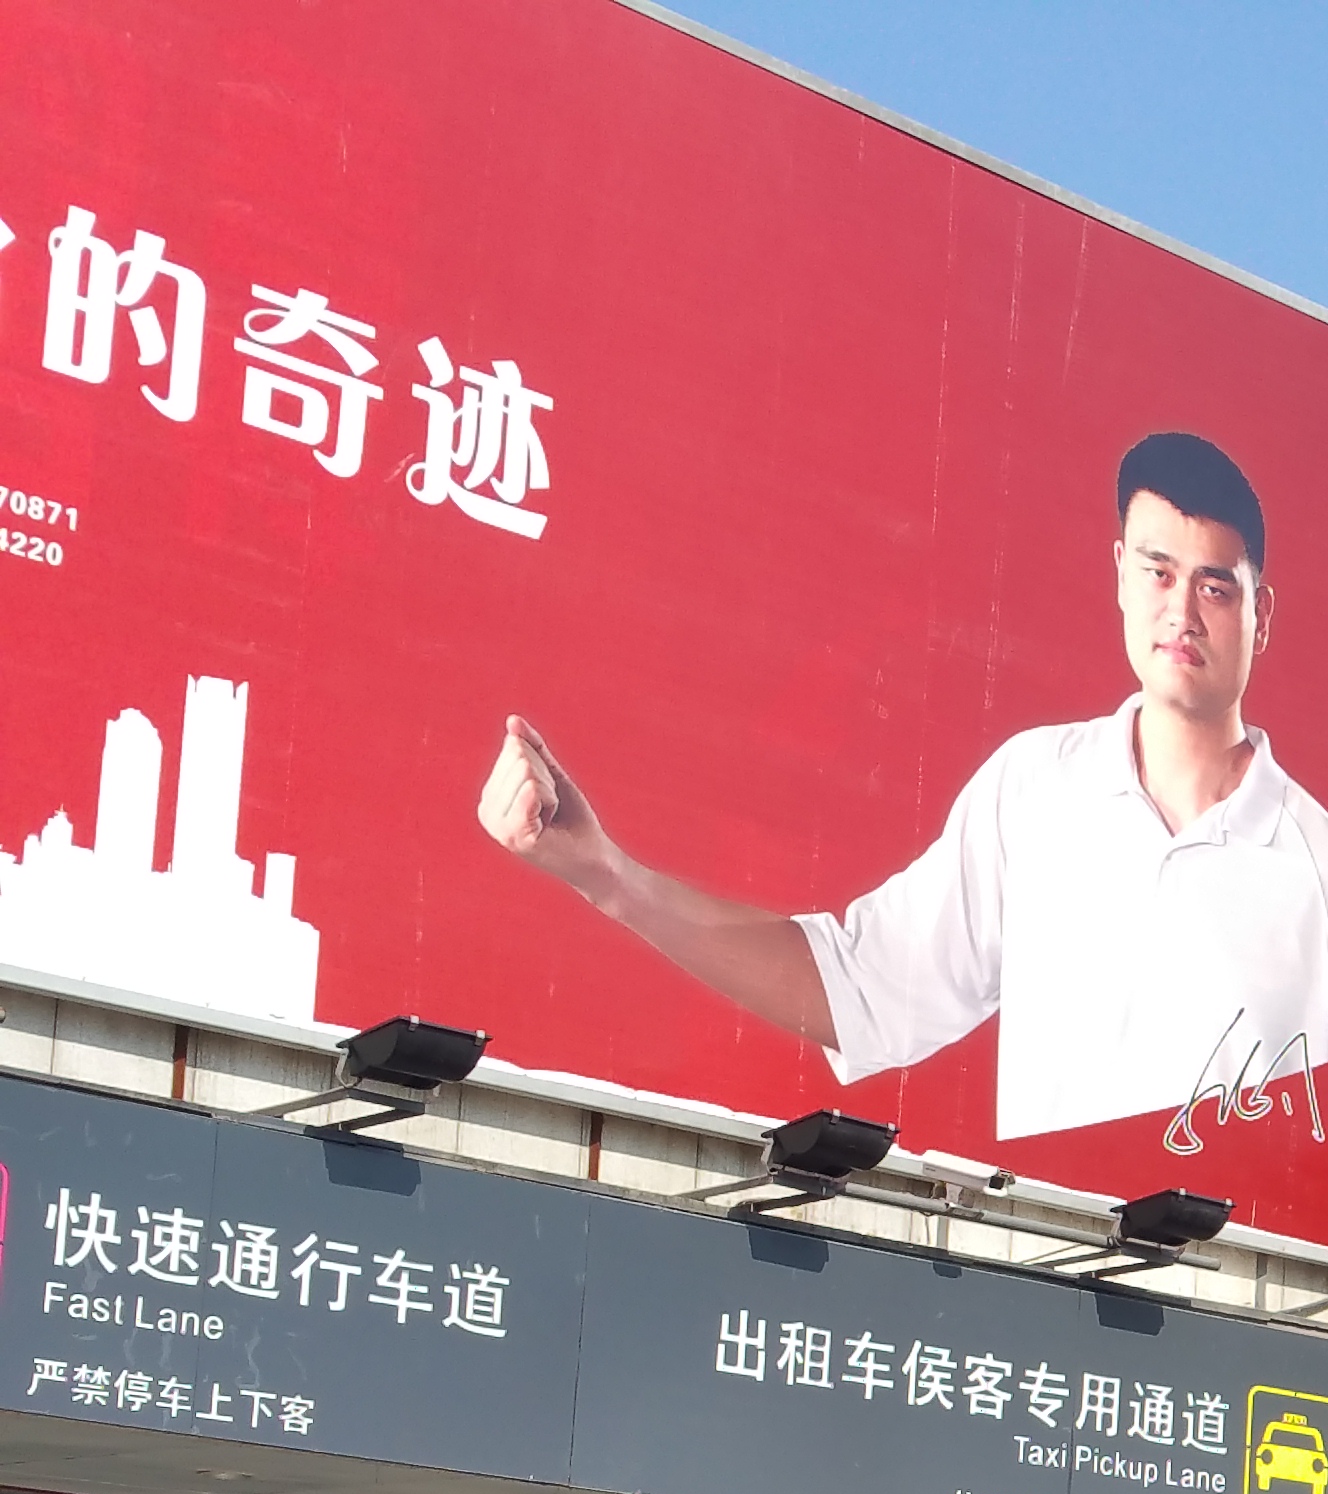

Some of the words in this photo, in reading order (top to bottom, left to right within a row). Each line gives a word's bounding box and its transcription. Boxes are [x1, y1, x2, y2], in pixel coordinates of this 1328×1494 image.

[0, 205, 554, 540] 的奇迹
[43, 1283, 123, 1326] Fast
[135, 1297, 225, 1340] Lane
[44, 1187, 510, 1338] 快速通行车道
[27, 1358, 316, 1436] 严禁停车上下客
[714, 1309, 1229, 1456] 出租车侯客专用通道
[1013, 1435, 1068, 1470] Taxi
[1075, 1449, 1160, 1488] Pickup
[1165, 1460, 1227, 1494] Lane
